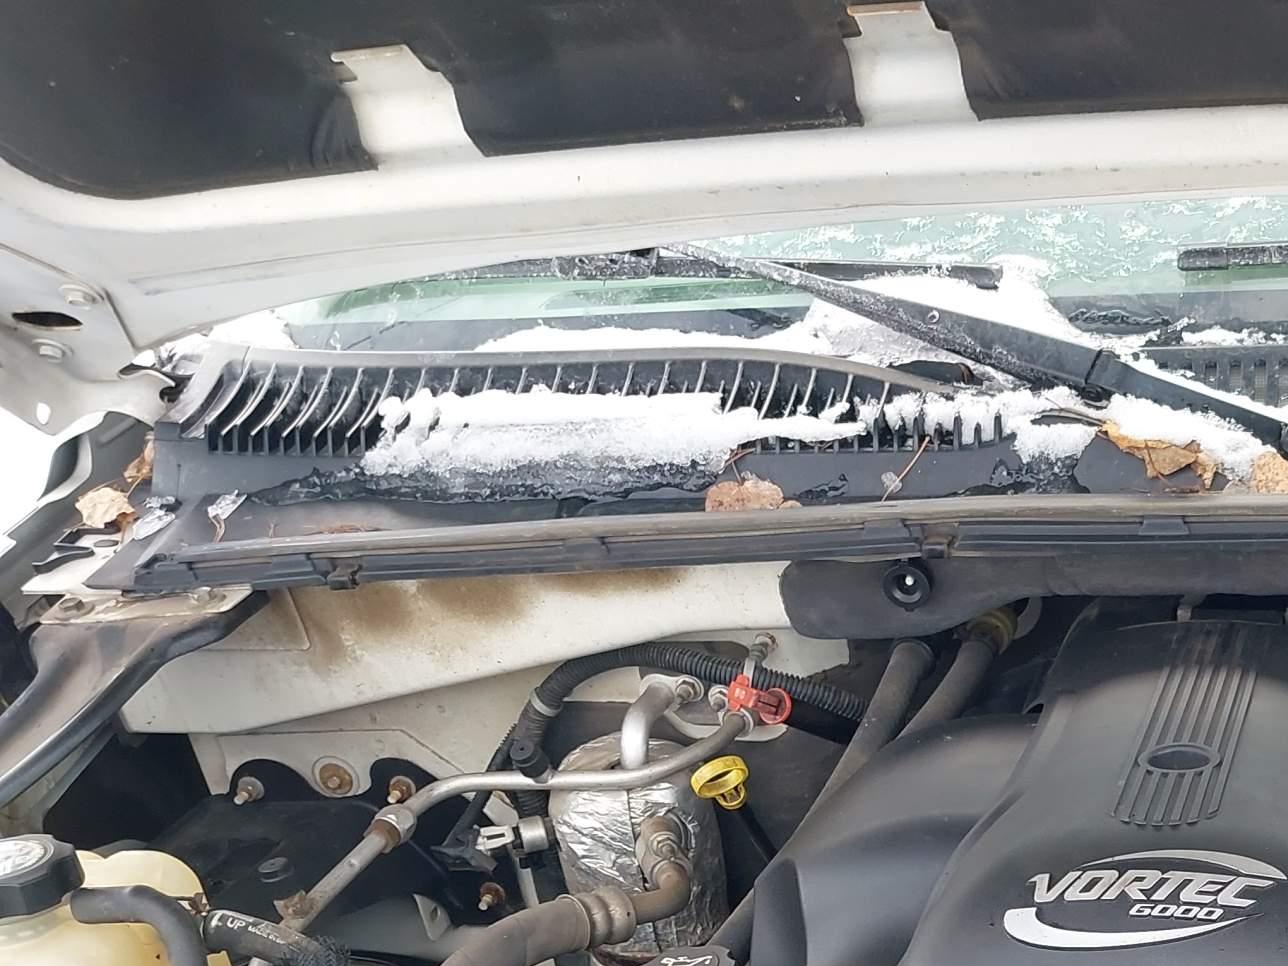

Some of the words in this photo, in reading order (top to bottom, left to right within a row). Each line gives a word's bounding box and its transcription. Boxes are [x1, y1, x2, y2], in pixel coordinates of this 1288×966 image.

[1027, 870, 1275, 907] VORTEC
[1128, 903, 1225, 921] 6000
[226, 917, 246, 930] UP
